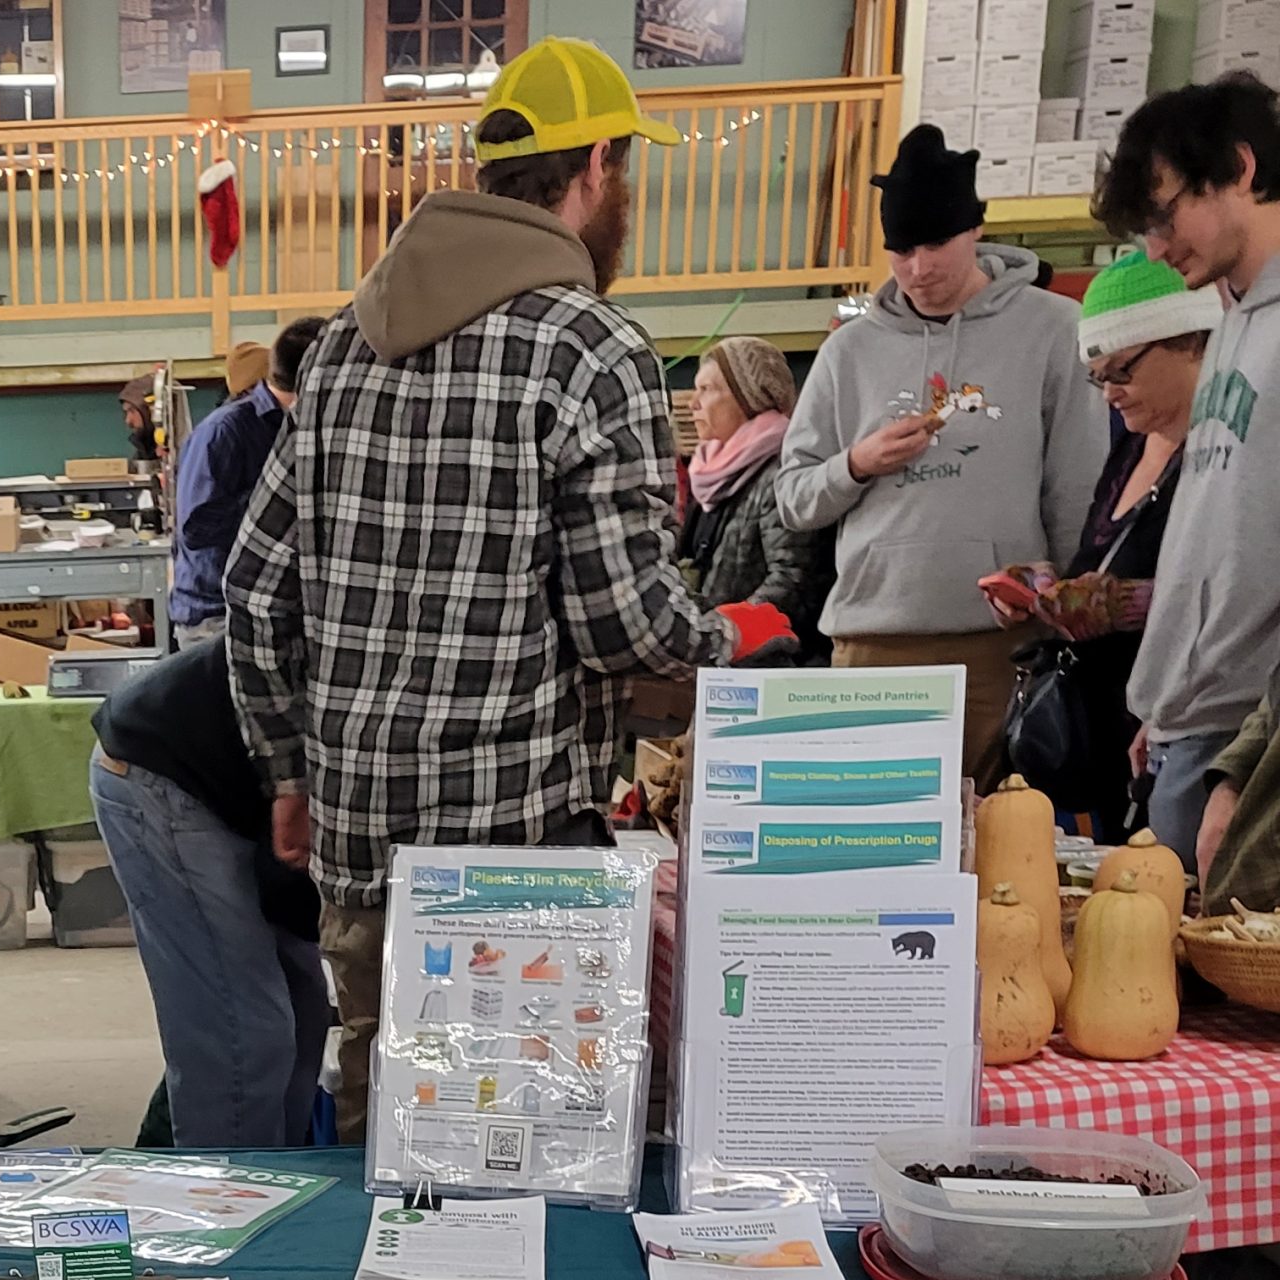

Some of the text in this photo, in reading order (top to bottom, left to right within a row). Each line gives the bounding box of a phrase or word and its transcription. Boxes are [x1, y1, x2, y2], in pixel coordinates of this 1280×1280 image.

[709, 690, 930, 704] BCSWA Donating to Food Pantries
[709, 767, 753, 779] BCSWA
[705, 834, 938, 848] BCSWA Disposing of Prescription Drugs
[472, 872, 519, 886] Plastic
[723, 916, 757, 926] Managing
[759, 915, 776, 924] Food
[828, 915, 842, 924] Bear
[843, 914, 873, 925] Country
[432, 1211, 488, 1219] Compost
[39, 1218, 122, 1238] BCSWA
